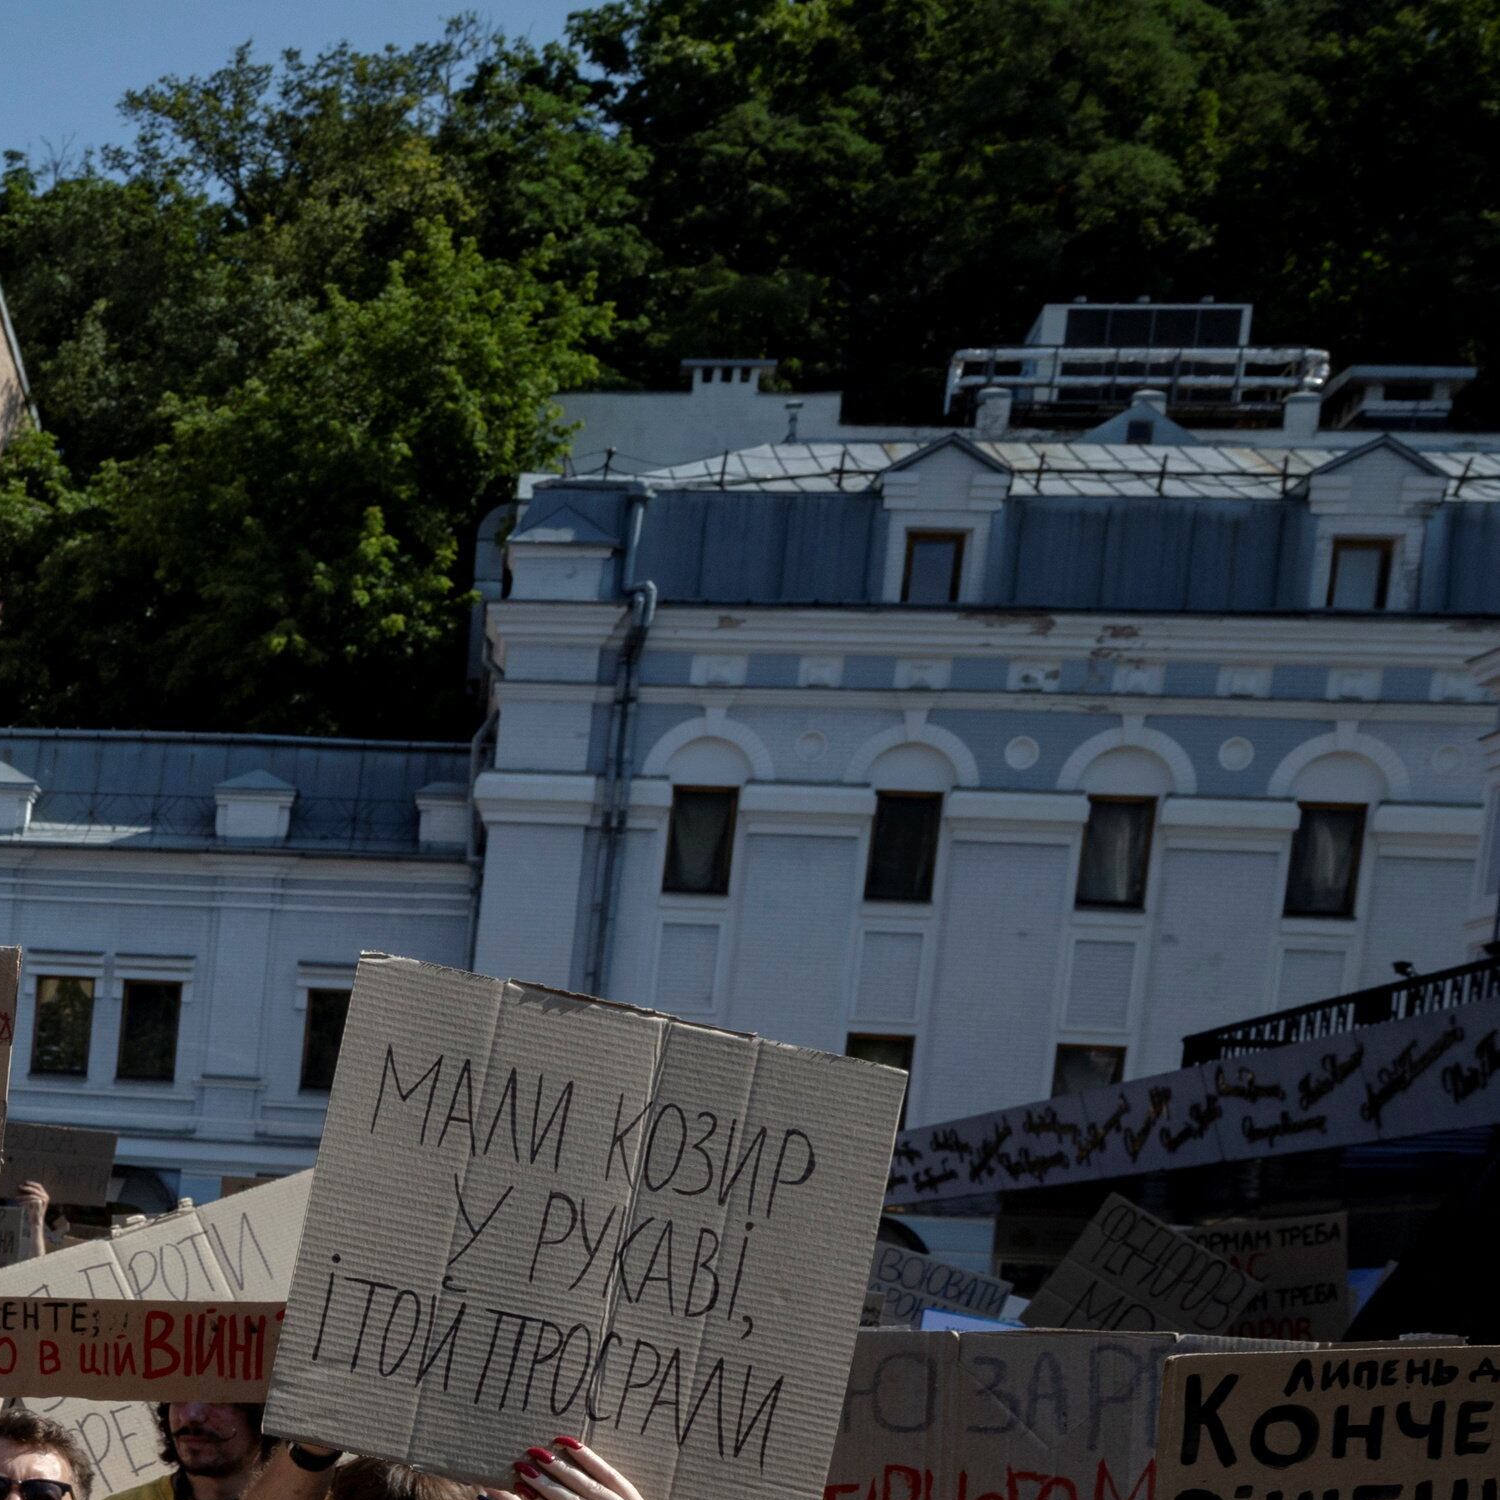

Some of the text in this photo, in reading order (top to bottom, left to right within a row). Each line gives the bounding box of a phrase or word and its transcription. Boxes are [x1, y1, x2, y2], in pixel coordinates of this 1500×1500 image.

[370, 1043, 575, 1174] МАЛИ
[604, 1092, 817, 1219] КОЗИР
[77, 1212, 274, 1300] ПРОТИ
[446, 1172, 514, 1267] У
[142, 1308, 286, 1381] ВІЙНІ
[474, 1307, 785, 1470] ПРОСРАЛИ
[1283, 1357, 1460, 1398] ЛИПЕНЬ
